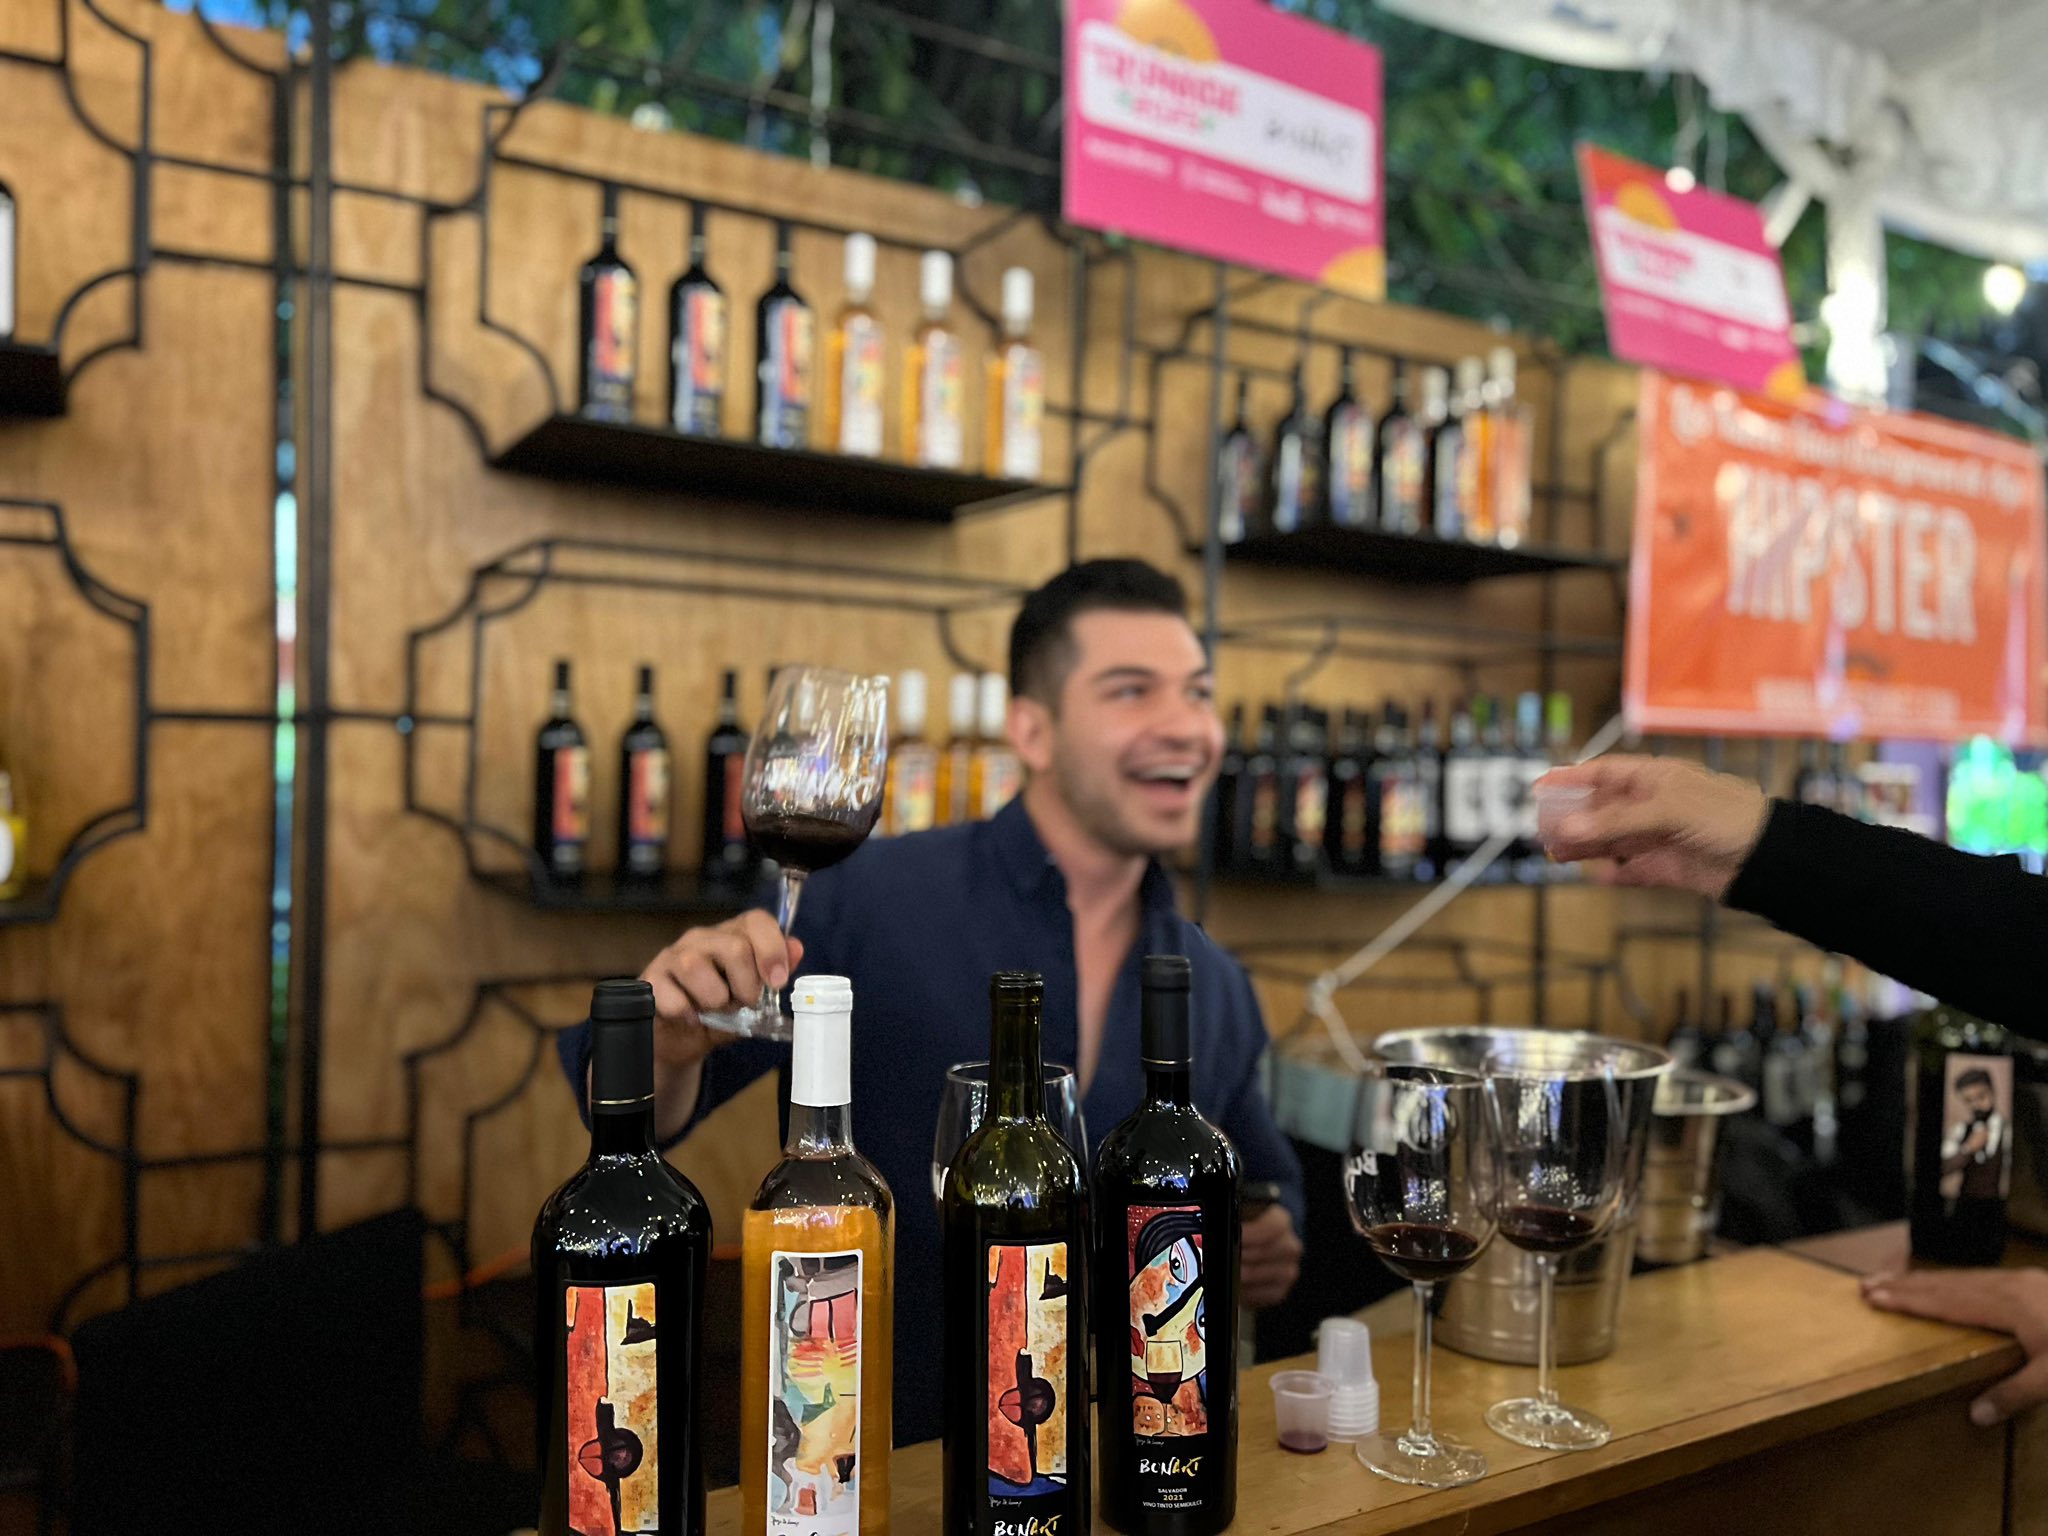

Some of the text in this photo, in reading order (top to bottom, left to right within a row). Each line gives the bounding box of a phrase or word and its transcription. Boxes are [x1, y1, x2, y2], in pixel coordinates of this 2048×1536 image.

[1724, 462, 1977, 645] HIPSTER
[1139, 1456, 1204, 1477] BONART
[993, 1514, 1062, 1536] BONART
